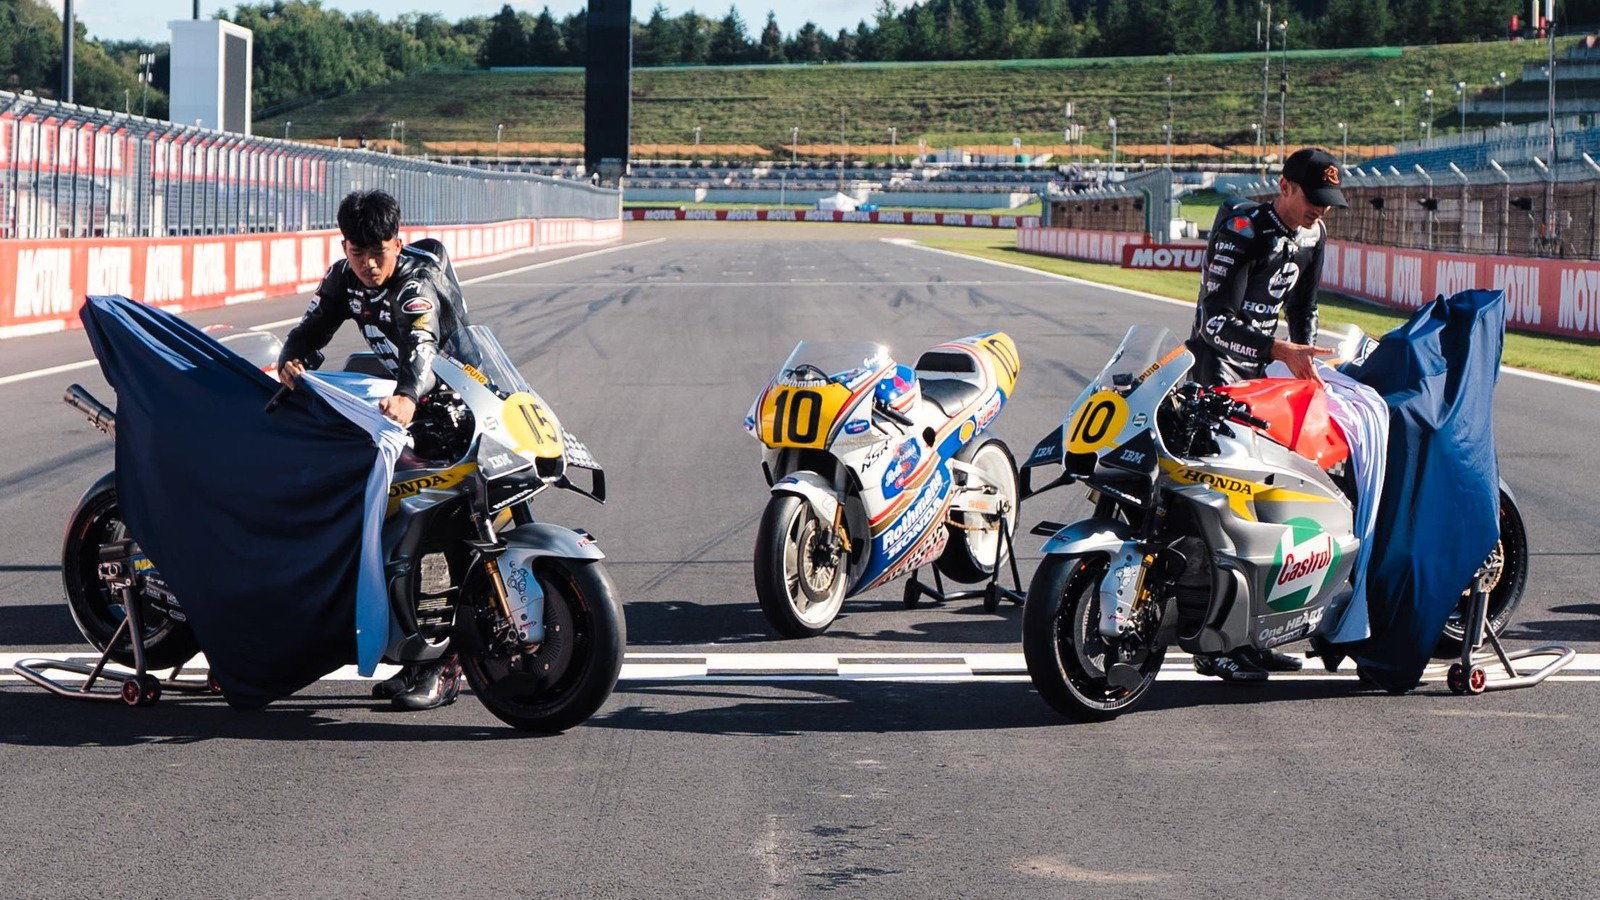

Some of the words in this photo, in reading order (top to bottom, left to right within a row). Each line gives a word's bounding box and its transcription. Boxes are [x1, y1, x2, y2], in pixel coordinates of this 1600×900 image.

[14, 248, 72, 317] MOTUL
[1392, 254, 1423, 306] MOTUL
[1493, 264, 1541, 325] MOTUL
[1558, 268, 1600, 332] MOT
[1214, 335, 1230, 348] One
[465, 365, 486, 384] PUIG
[1138, 363, 1160, 382] PUIG
[518, 403, 558, 445] 15
[773, 389, 823, 444] 10
[1070, 400, 1116, 444] 10
[488, 452, 513, 470] IBM
[1035, 446, 1056, 458] IBM
[1119, 450, 1146, 465] IBM
[389, 475, 448, 498] ONDA
[1182, 468, 1253, 496] HONDA
[881, 468, 943, 551] Rothmans
[1277, 536, 1332, 586] Castrol
[1258, 626, 1284, 641] One
